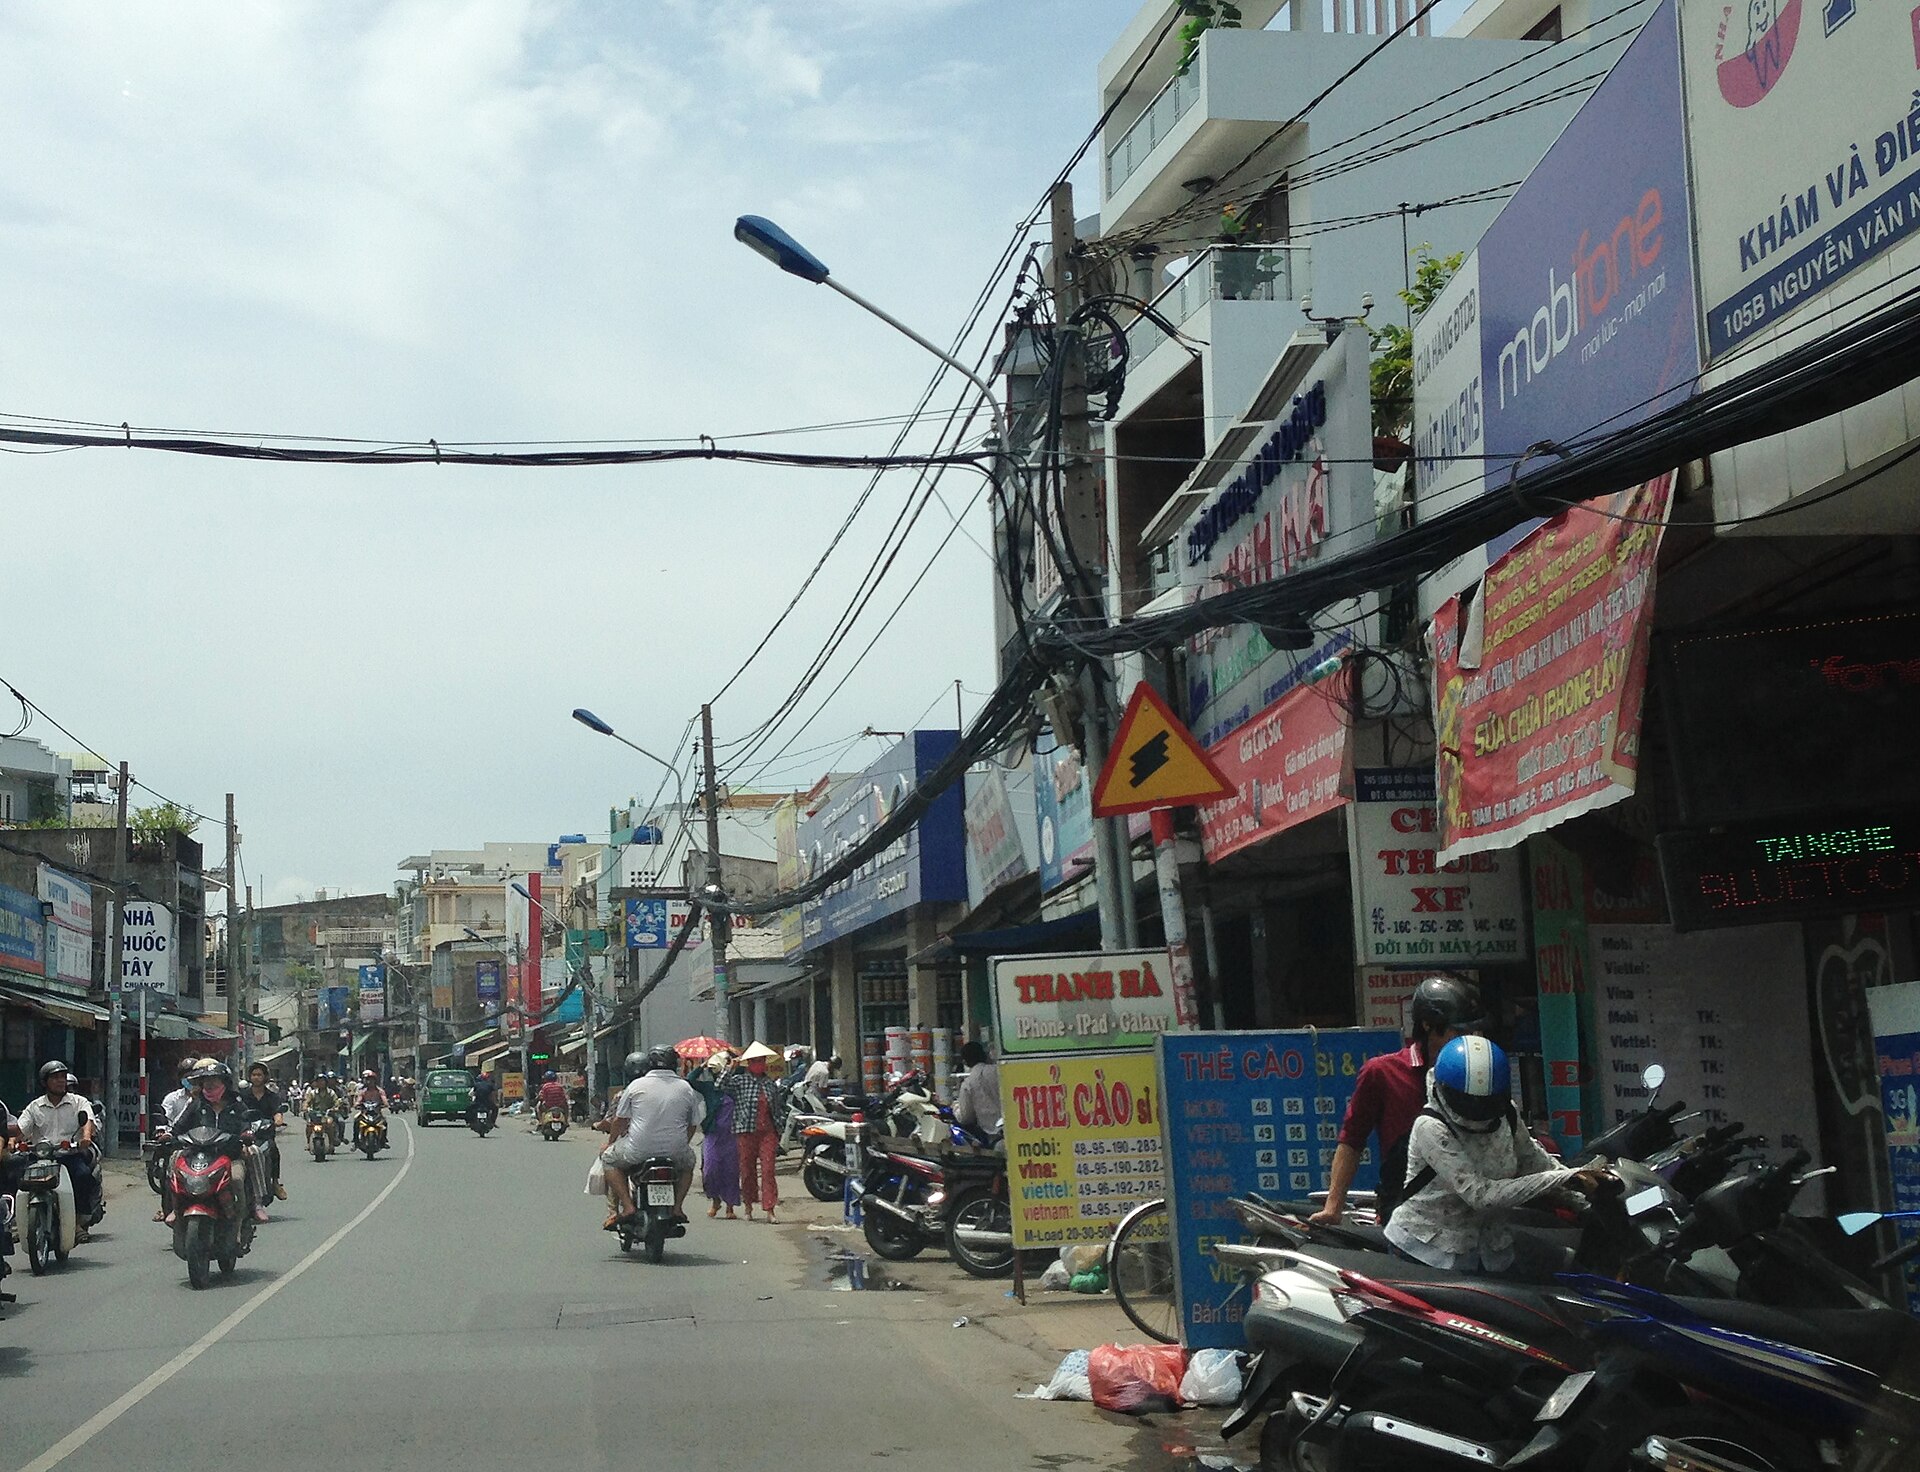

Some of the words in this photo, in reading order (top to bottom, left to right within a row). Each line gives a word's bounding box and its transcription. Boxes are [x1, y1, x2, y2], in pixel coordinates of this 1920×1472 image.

[1739, 193, 1820, 273] KHÁM
[1826, 143, 1868, 209] VÀ
[1724, 293, 1766, 338] 105B
[1769, 234, 1855, 311] NGUYỄN
[1858, 200, 1905, 251] VĂN
[1498, 187, 1664, 410] mobifone
[1543, 669, 1593, 726] IPHONE
[122, 906, 156, 927] NHÀ
[109, 930, 167, 952] HUỐC
[121, 957, 154, 977] TÂY
[1014, 971, 1116, 1004] THANH
[1118, 960, 1164, 999] HÀ
[1016, 1015, 1067, 1039] IPhone
[1075, 1012, 1109, 1036] IPad
[1119, 1011, 1169, 1034] Galaxy
[1178, 1044, 1236, 1082] THẺ
[1242, 1041, 1305, 1081] CÀO
[1341, 1052, 1357, 1077] &
[1012, 1064, 1071, 1130] THẺ
[1072, 1069, 1133, 1128] CÀO
[1255, 1101, 1268, 1113] 48
[1286, 1100, 1300, 1112] 95
[1017, 1137, 1061, 1158] mobi:
[1018, 1159, 1058, 1180] vina:
[1021, 1180, 1074, 1200] viettel:
[1023, 1203, 1074, 1221] vietnam:
[1024, 1229, 1064, 1243] M-Load
